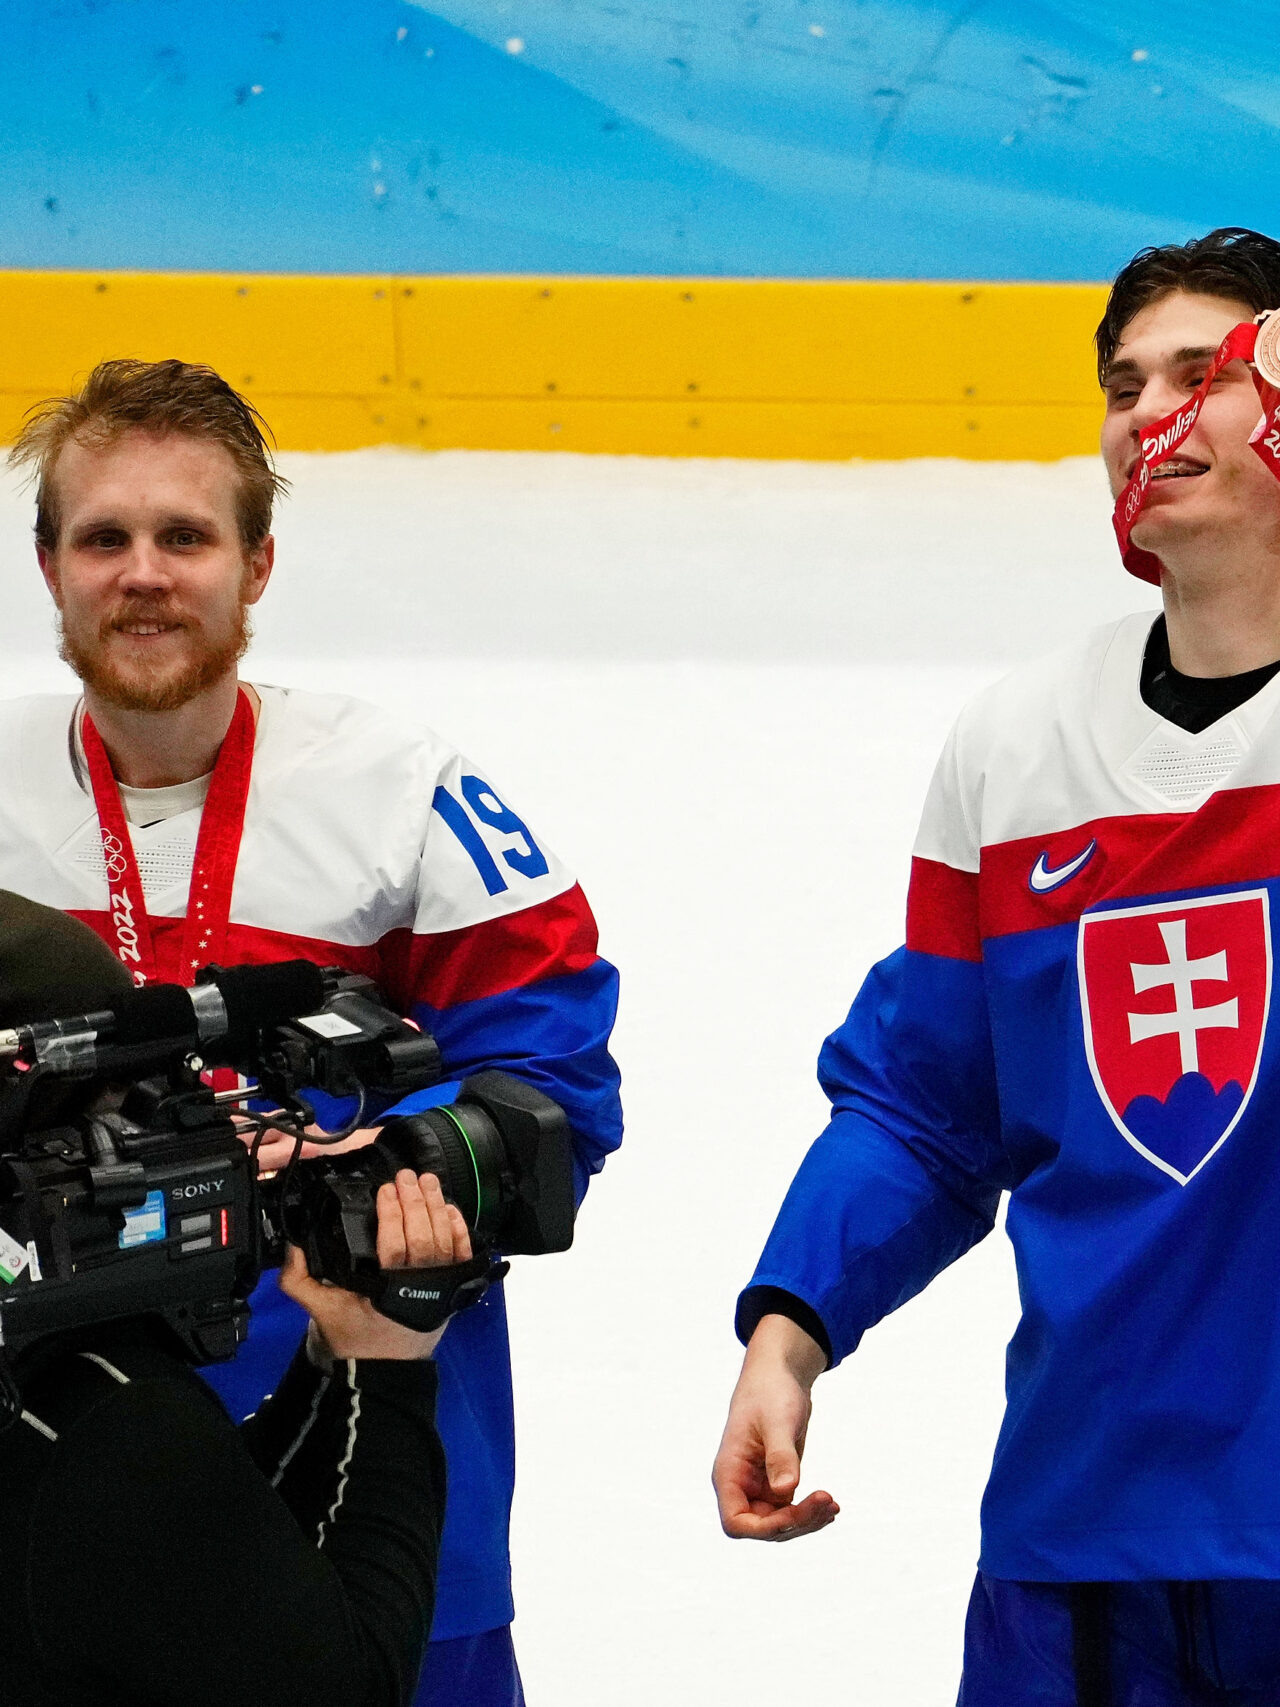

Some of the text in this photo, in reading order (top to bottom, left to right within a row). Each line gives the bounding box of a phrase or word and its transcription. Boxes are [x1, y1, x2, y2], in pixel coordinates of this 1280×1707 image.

[1142, 400, 1200, 462] BEIJING
[431, 775, 550, 897] 19
[111, 886, 142, 963] 2022
[171, 1179, 225, 1200] SONY
[398, 1286, 441, 1300] Canon
